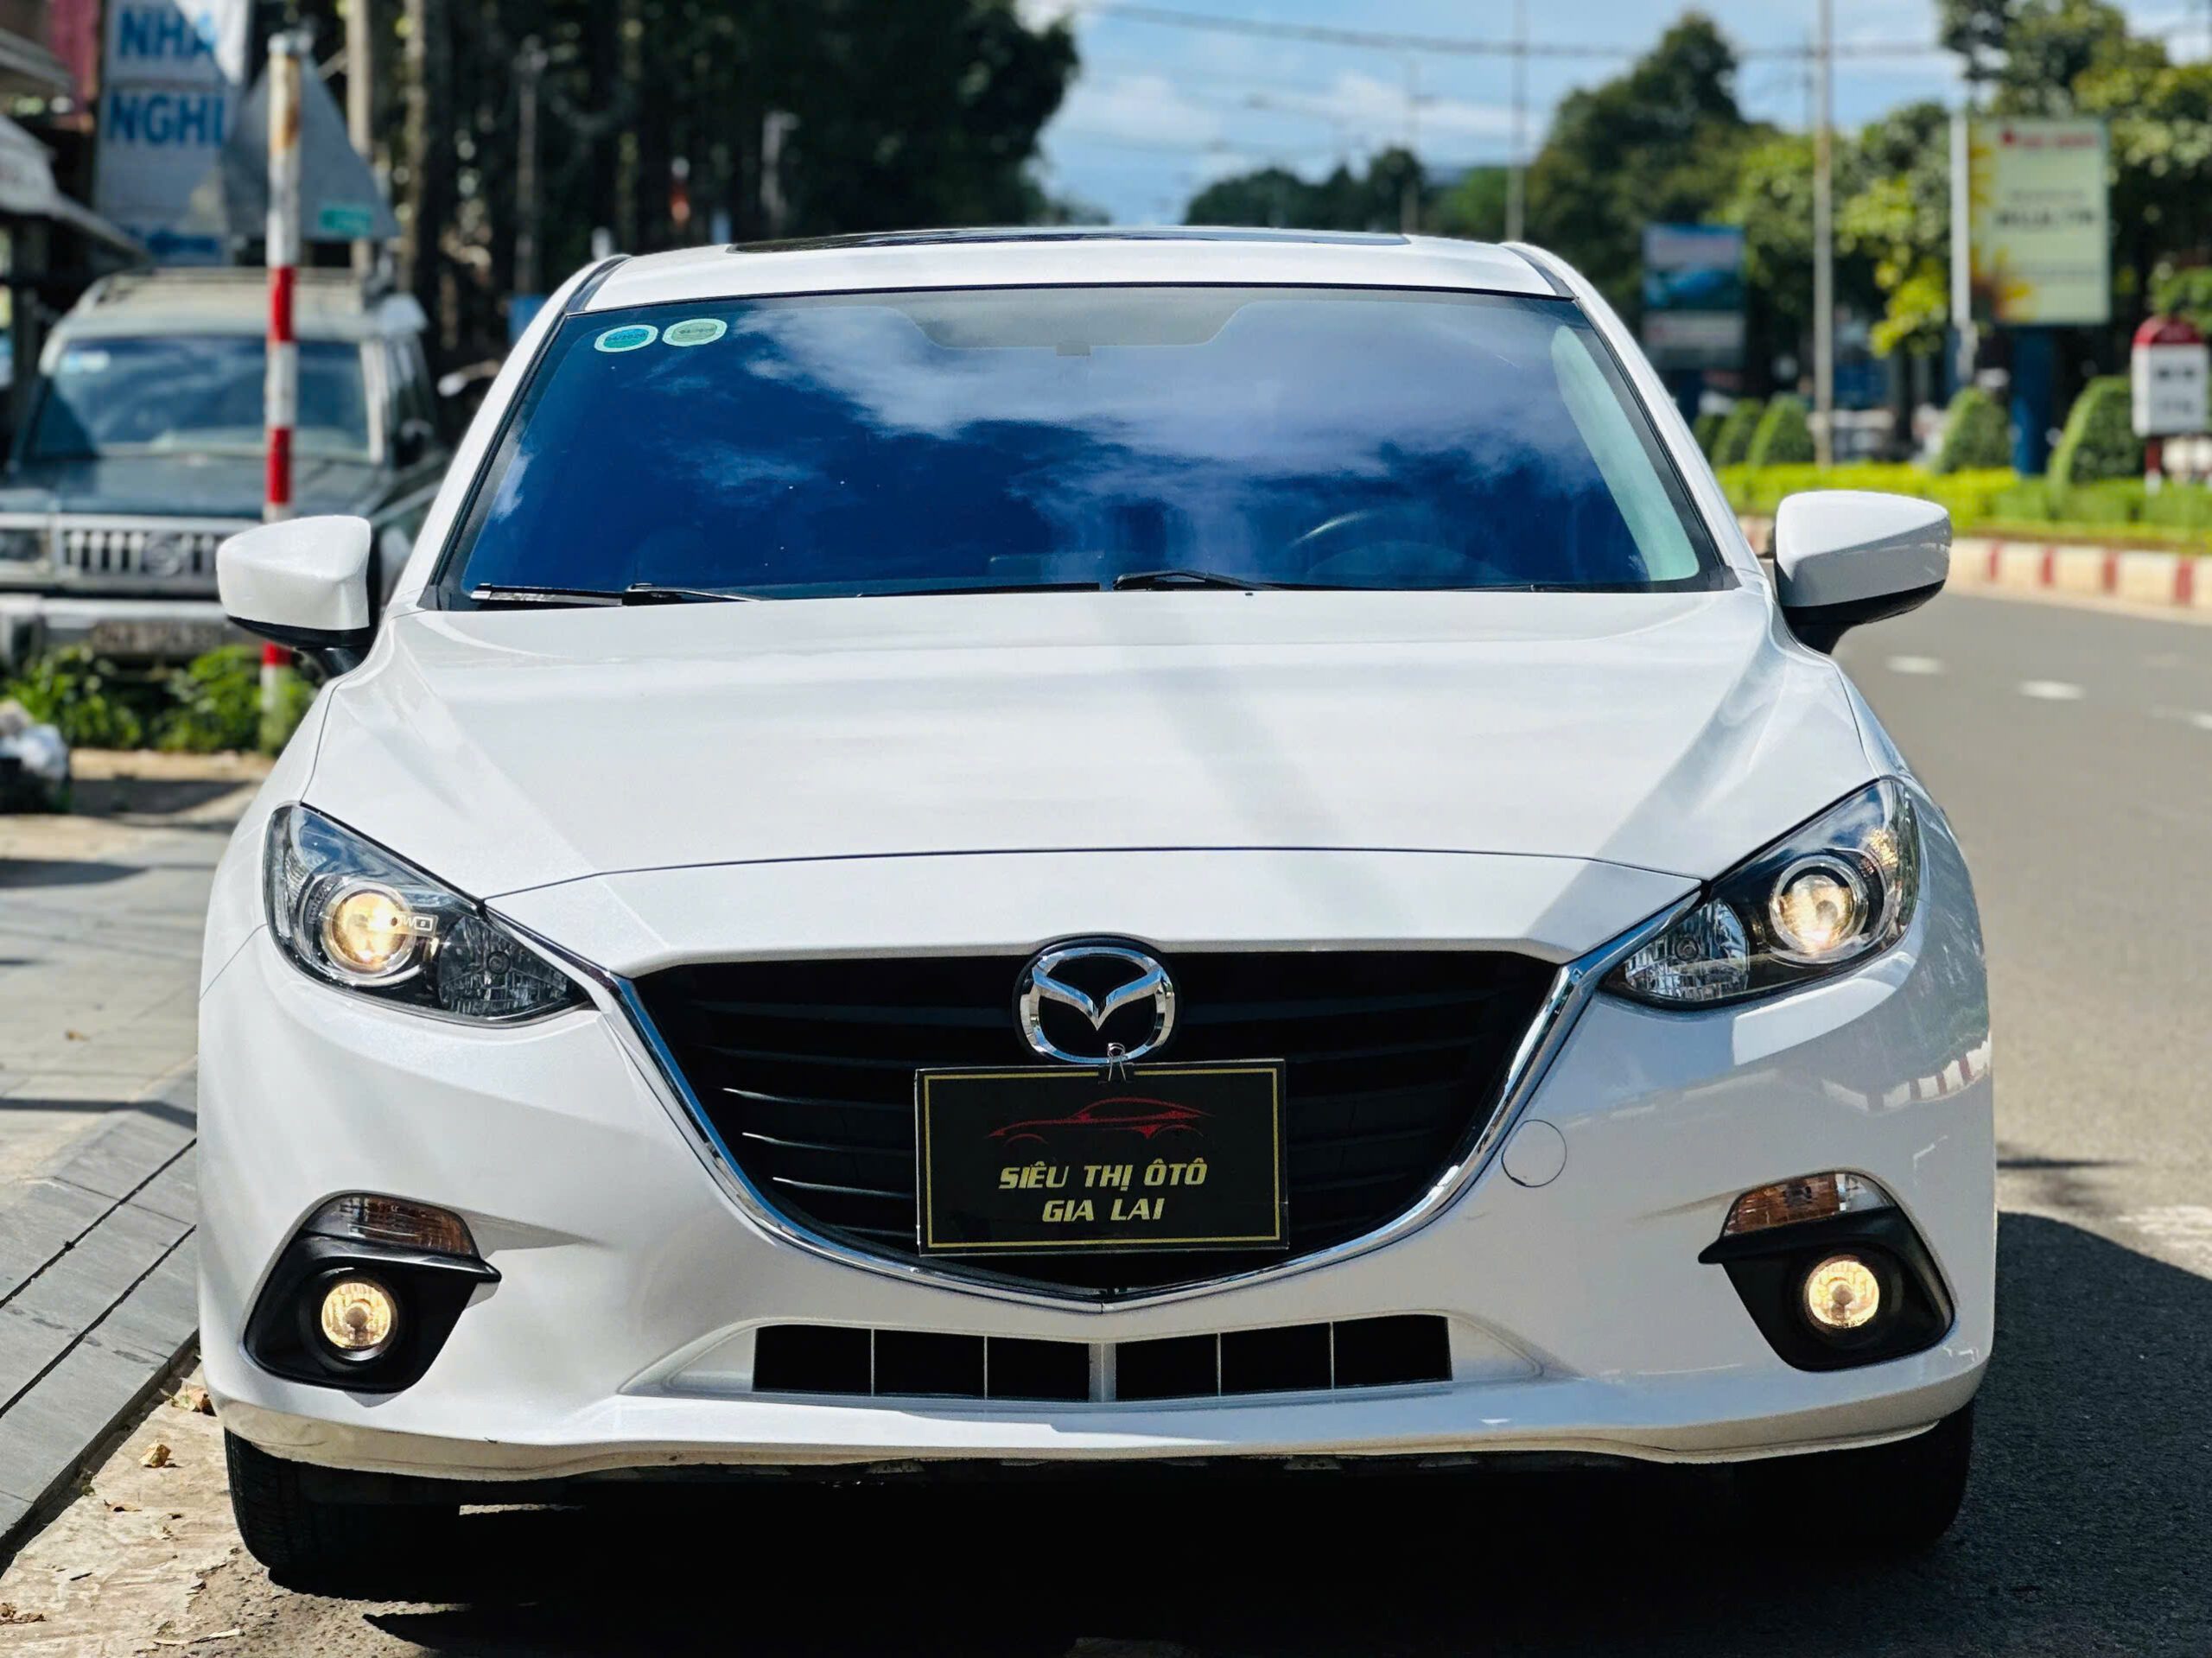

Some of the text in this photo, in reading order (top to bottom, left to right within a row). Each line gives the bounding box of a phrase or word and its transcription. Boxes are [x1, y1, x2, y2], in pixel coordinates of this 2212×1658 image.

[999, 1157, 1208, 1191] SIÊU THỊ ÔTÔ
[1042, 1197, 1166, 1223] GIA LAI
